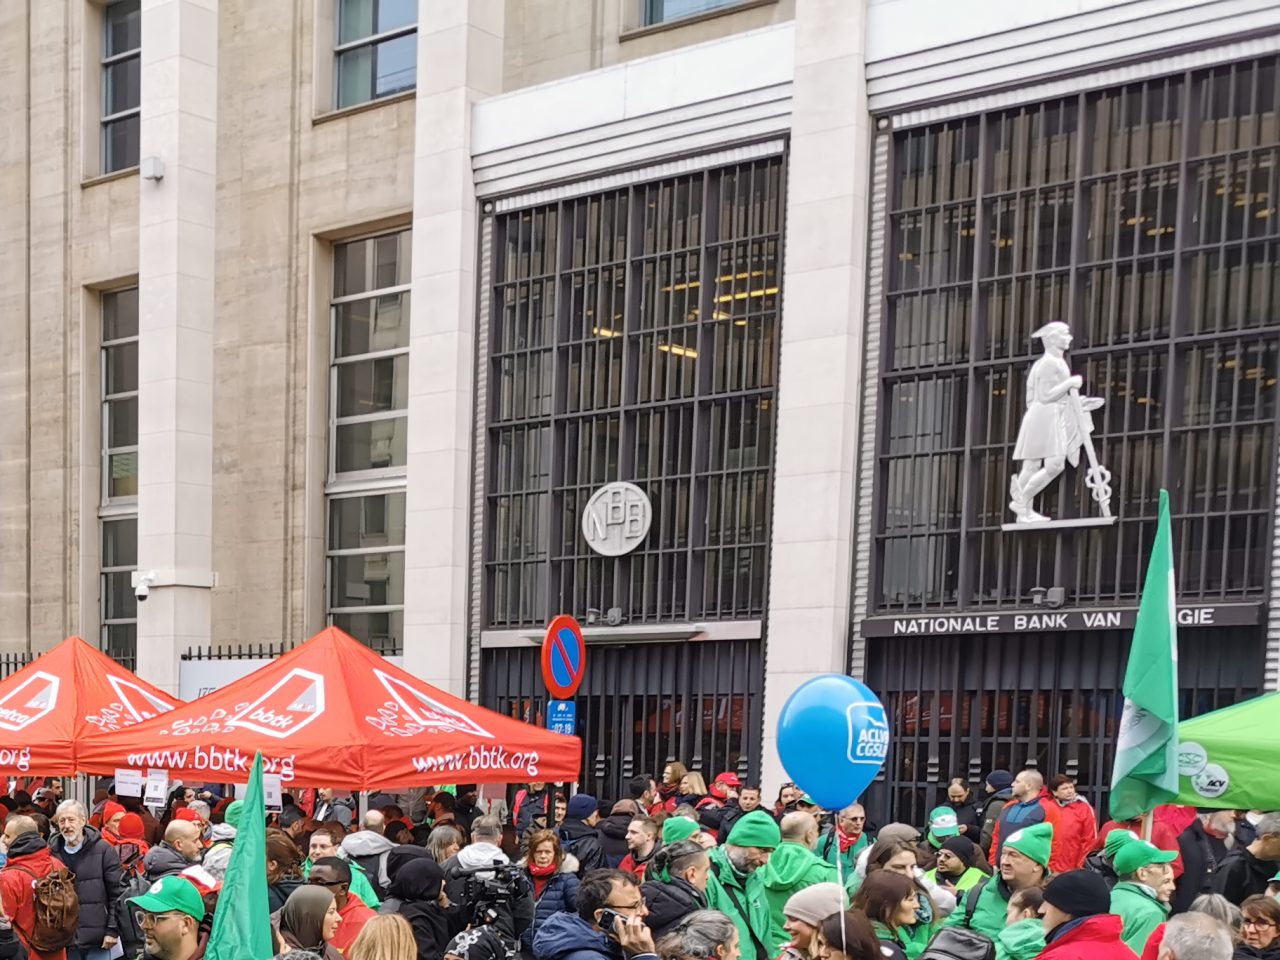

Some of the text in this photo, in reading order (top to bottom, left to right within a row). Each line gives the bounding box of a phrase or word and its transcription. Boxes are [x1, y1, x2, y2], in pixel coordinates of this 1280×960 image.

[894, 616, 999, 634] NATIONALE
[1014, 613, 1068, 631] BANK
[1083, 612, 1121, 629] VAN
[248, 707, 293, 728] bbtk
[412, 745, 539, 776] www.bbtk.org
